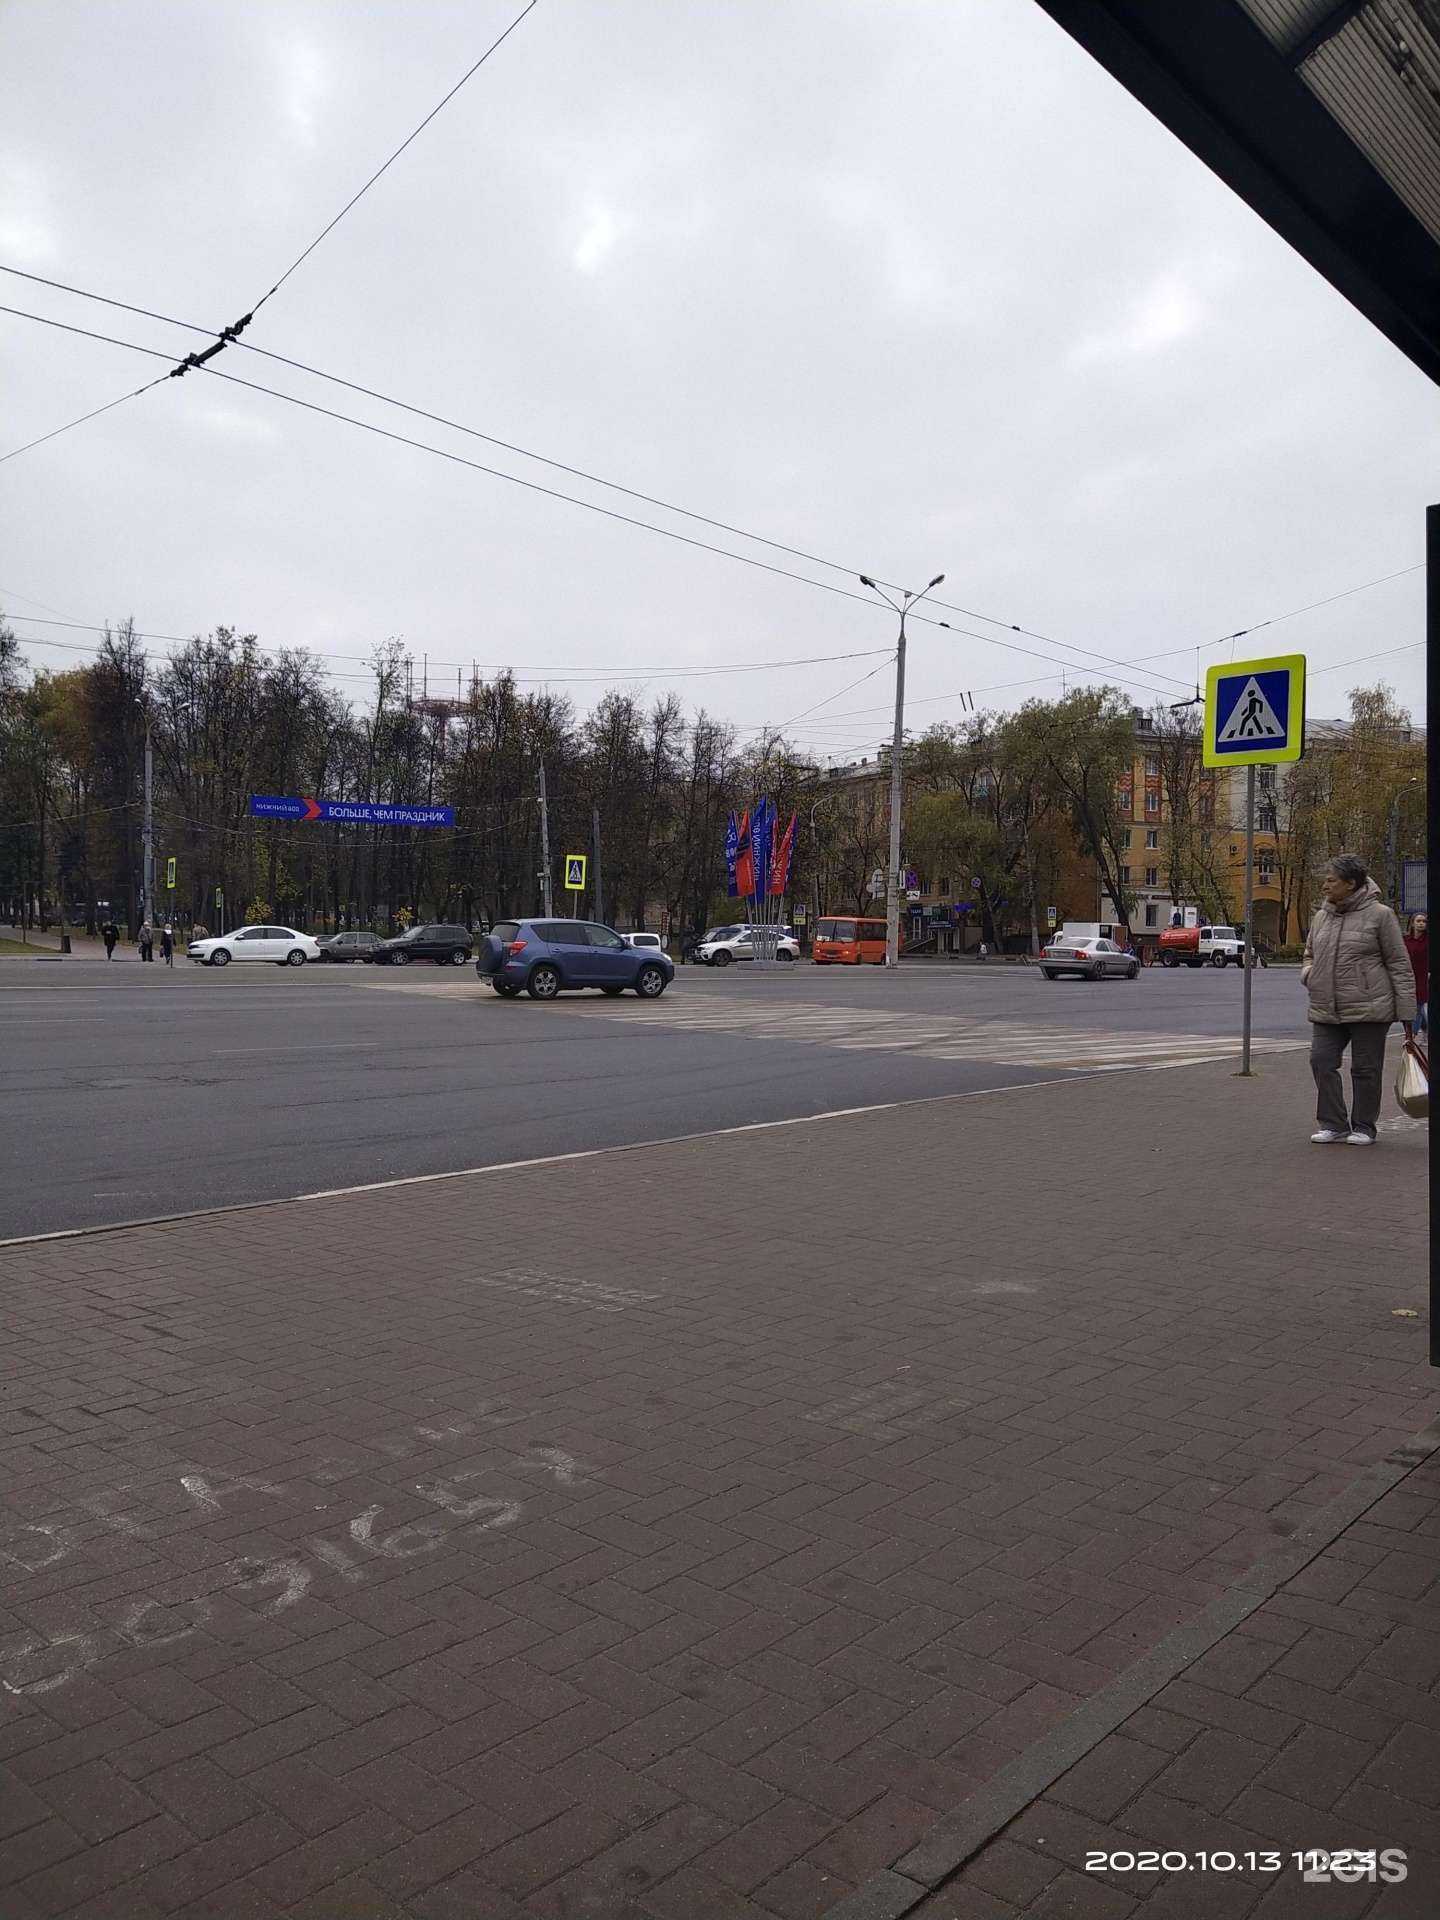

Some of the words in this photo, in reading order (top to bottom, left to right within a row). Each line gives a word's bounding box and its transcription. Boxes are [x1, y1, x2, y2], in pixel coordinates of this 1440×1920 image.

[328, 806, 372, 820] БОЛЬШЕ,
[373, 809, 393, 820] ЧЕМ
[394, 810, 446, 823] ПРАЗДНИК
